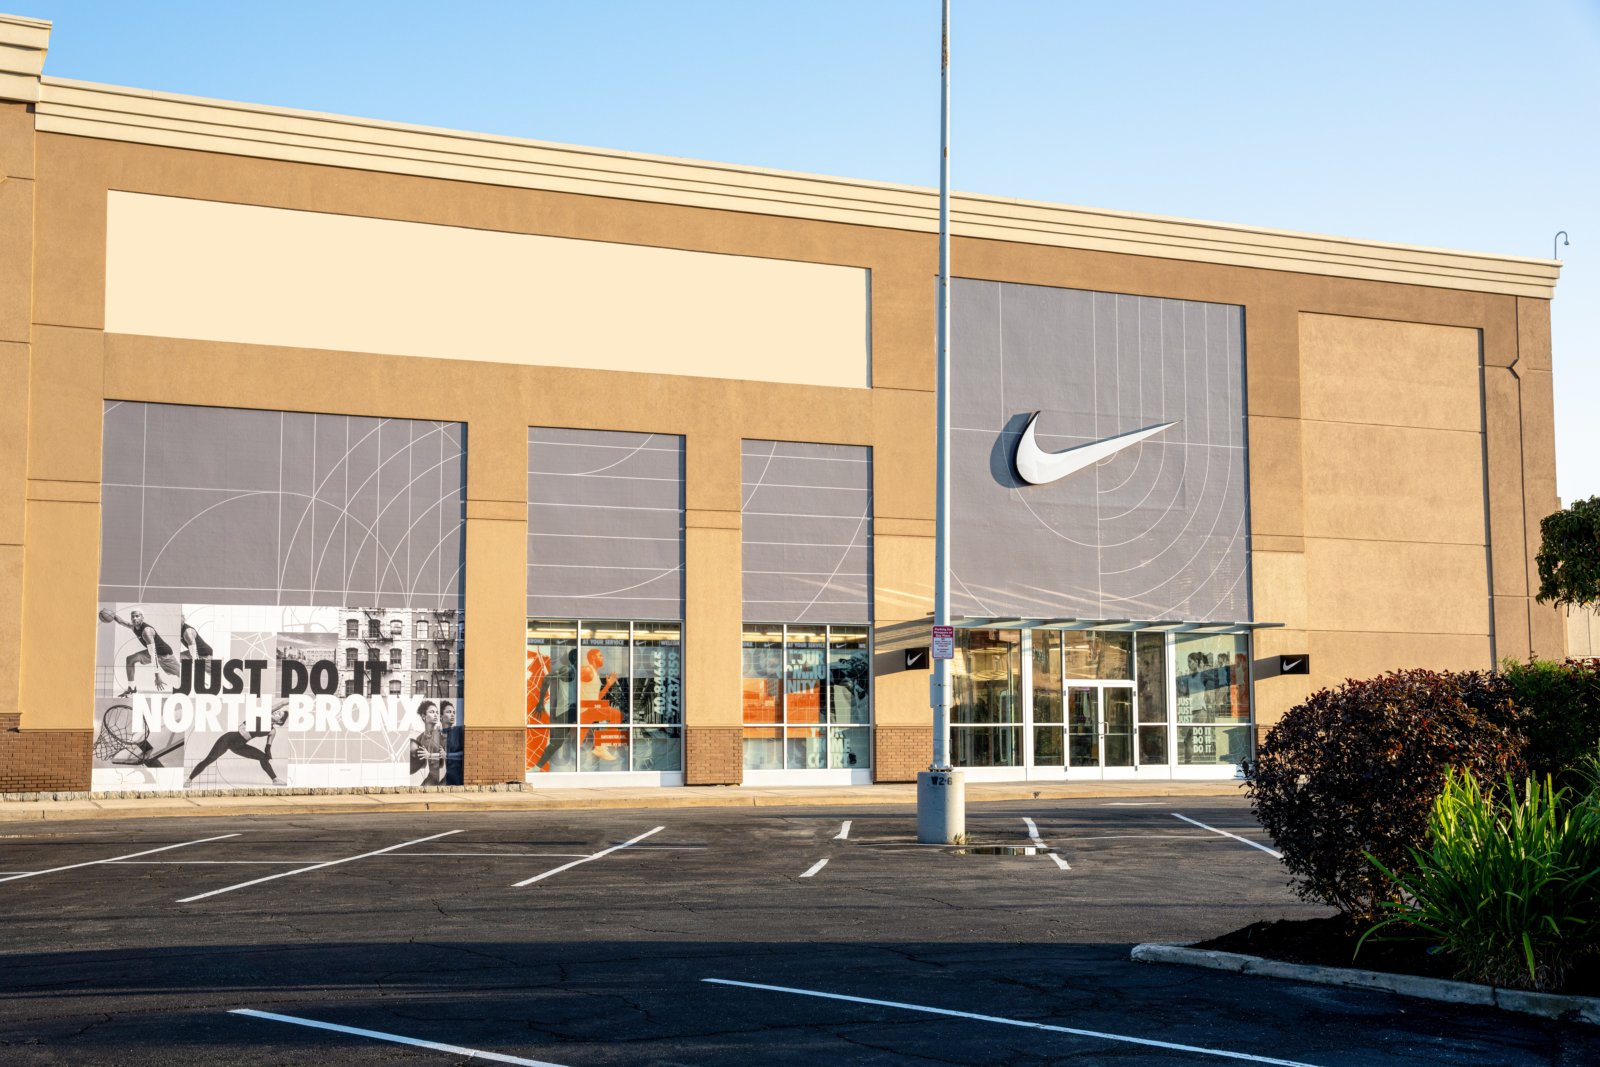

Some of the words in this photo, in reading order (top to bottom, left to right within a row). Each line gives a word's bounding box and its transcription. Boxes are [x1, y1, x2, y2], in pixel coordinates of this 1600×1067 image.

[173, 659, 267, 696] JUST
[281, 660, 339, 695] DO
[354, 660, 387, 695] IT
[654, 651, 666, 715] 40.84665
[1178, 698, 1192, 706] JUST
[131, 694, 272, 732] NORTH
[288, 693, 426, 732] BRONX
[1178, 706, 1192, 714] JUST
[1192, 727, 1203, 735] DO
[1205, 727, 1211, 735] IT
[1192, 736, 1204, 744] DO
[1205, 736, 1211, 744] IT
[1193, 745, 1204, 753] DO
